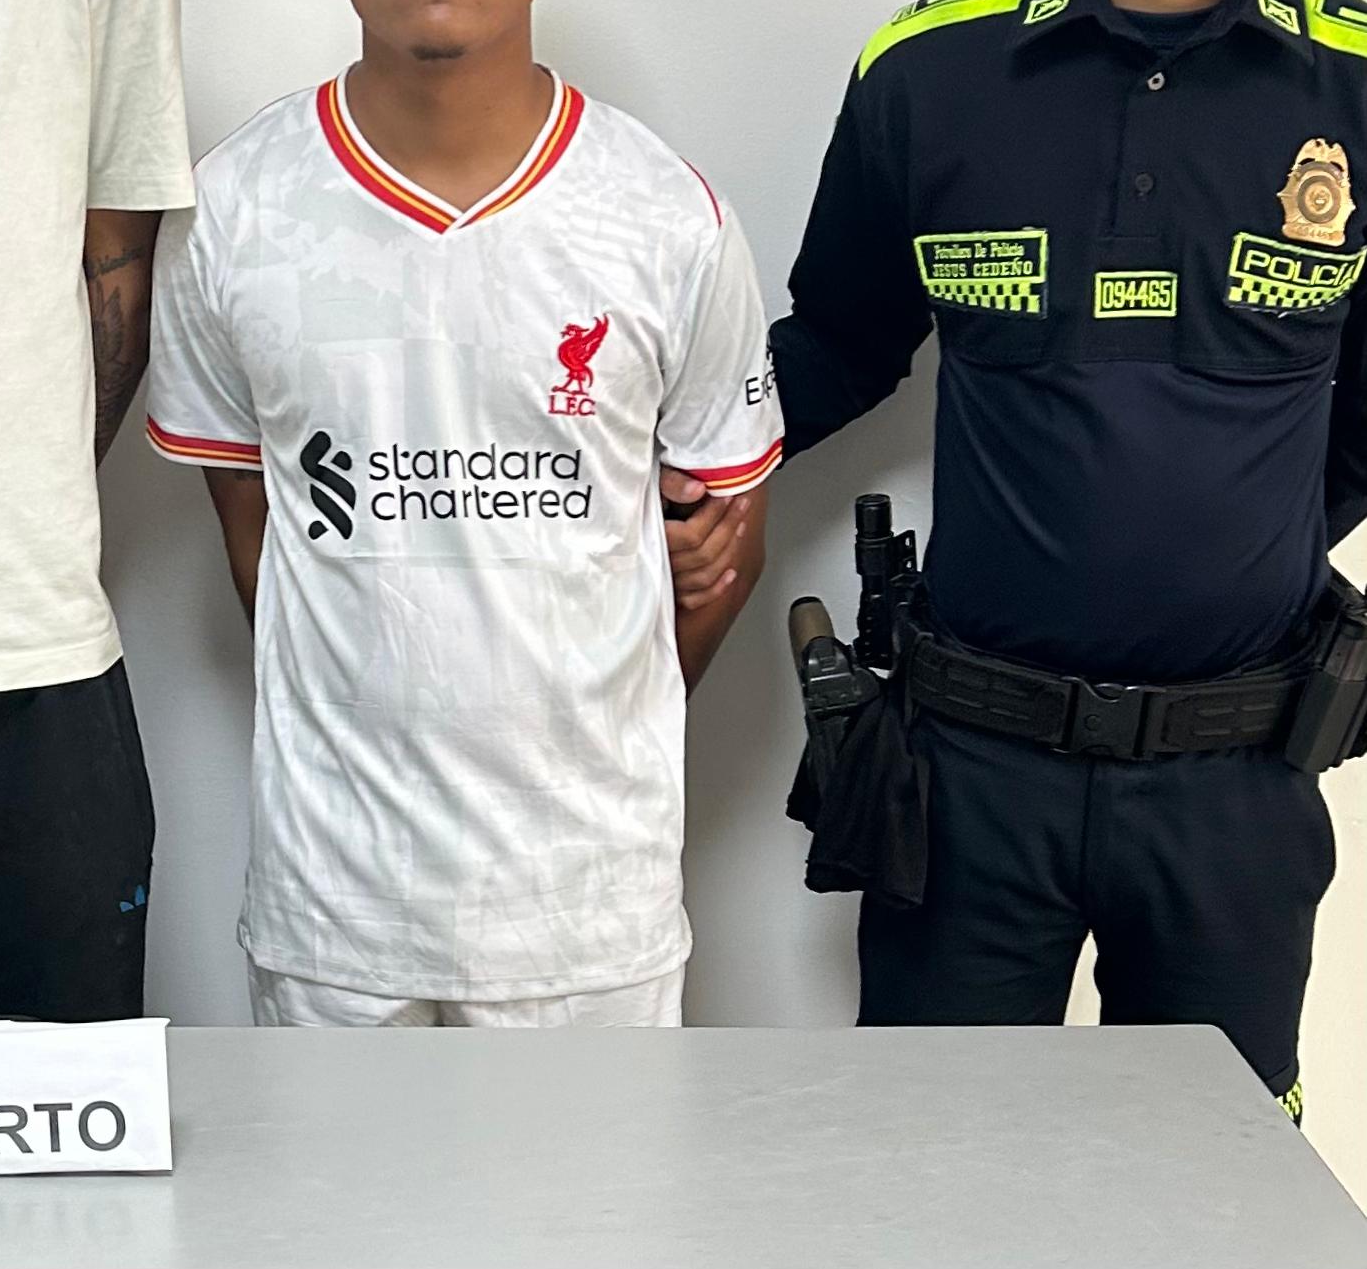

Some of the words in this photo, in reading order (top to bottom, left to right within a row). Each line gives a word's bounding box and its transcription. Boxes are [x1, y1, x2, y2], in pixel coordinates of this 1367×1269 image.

[932, 263, 968, 278] JESUS
[1101, 279, 1172, 310] 094465
[368, 442, 583, 482] standard
[370, 484, 593, 521] chartered
